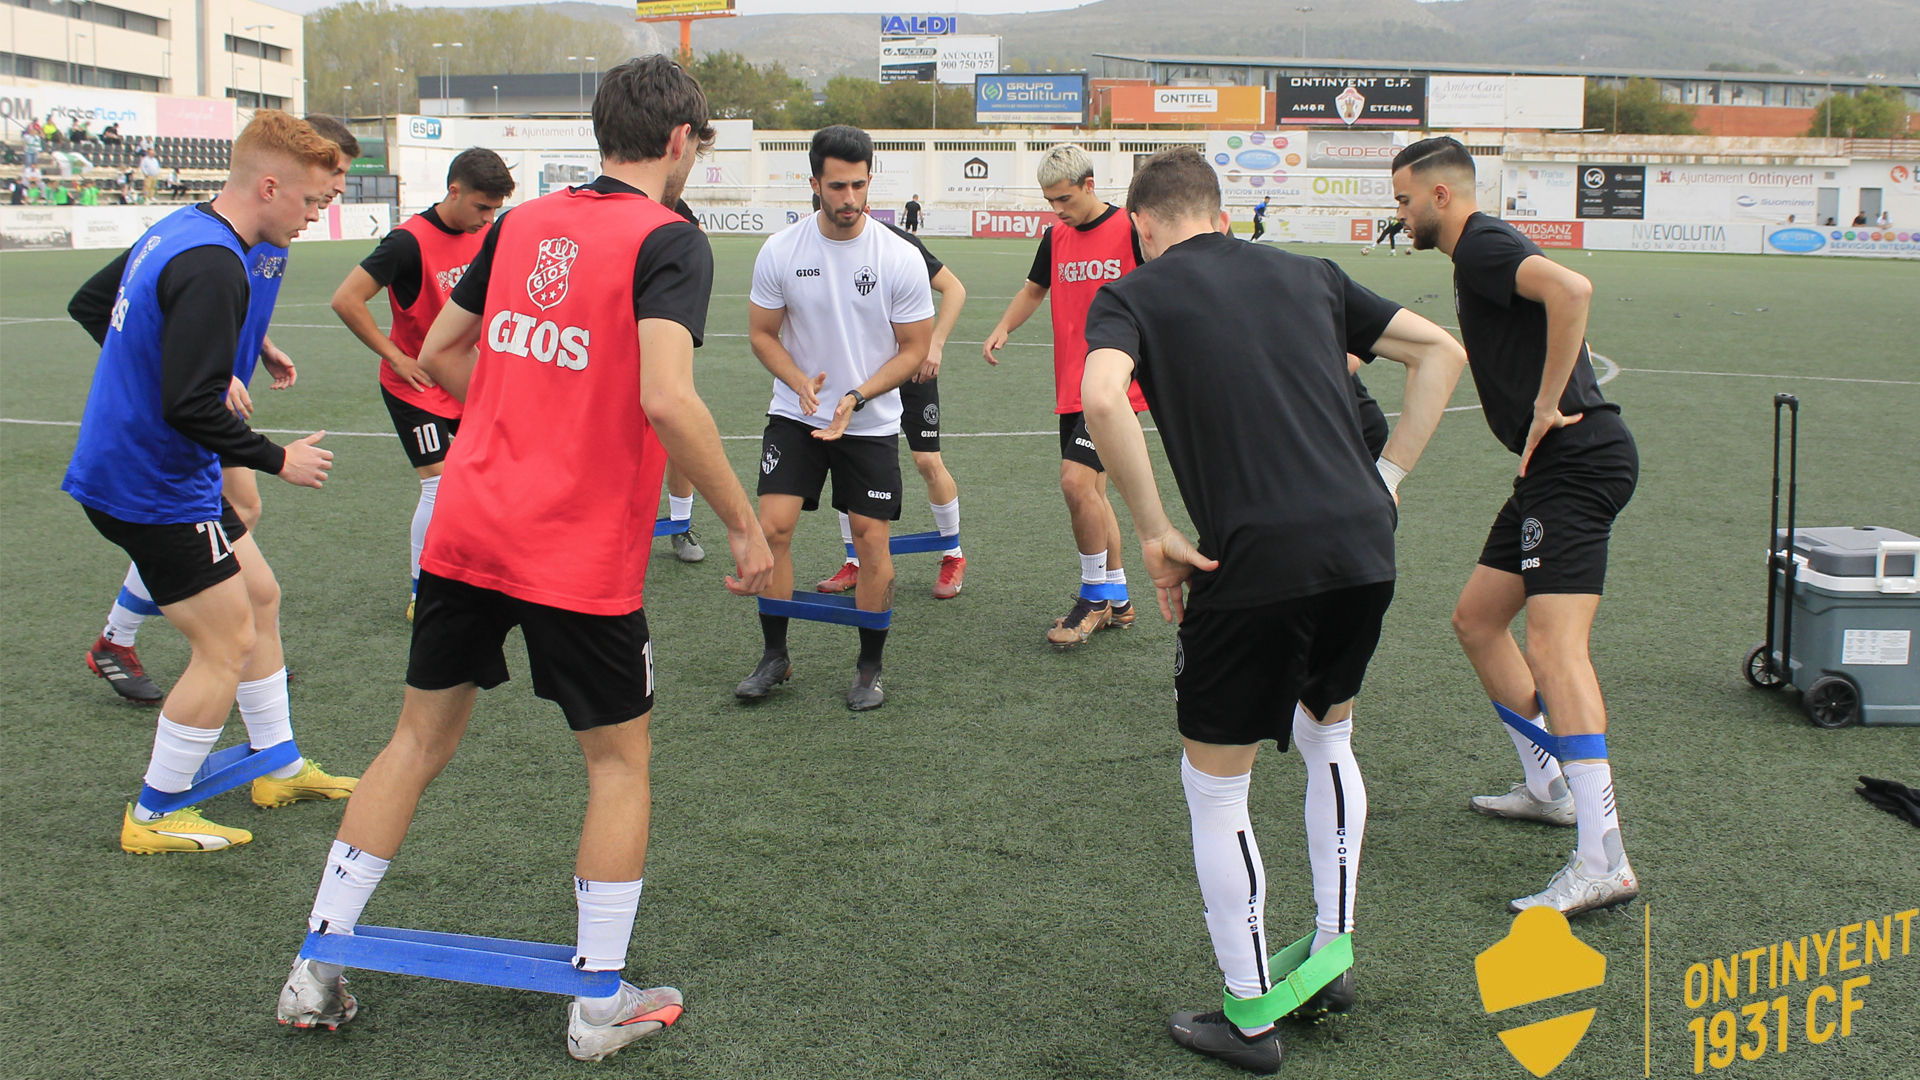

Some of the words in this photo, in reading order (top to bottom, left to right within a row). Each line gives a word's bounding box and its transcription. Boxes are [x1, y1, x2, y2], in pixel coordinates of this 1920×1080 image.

[883, 16, 957, 34] ALDI
[941, 51, 995, 60] ANÚNCIATE
[941, 61, 957, 69] 900
[960, 61, 976, 69] 750
[978, 60, 994, 69] 757
[1006, 82, 1054, 90] GRUPO
[1291, 77, 1377, 88] ONTINYENT
[1384, 78, 1411, 88] C.F.
[1006, 90, 1079, 101] solitium
[1160, 94, 1212, 103] ONTITEL
[521, 127, 574, 138] Ajuntament
[1679, 172, 1744, 185] Ajuntament
[1748, 171, 1814, 187] Ontinyent
[1761, 197, 1815, 207] Suominen
[975, 211, 1041, 238] Pinay
[533, 262, 568, 289] GIOS
[796, 268, 820, 277] GIOS
[1064, 259, 1122, 282] GIOS
[488, 310, 590, 371] GIOS
[412, 423, 440, 455] 10
[921, 430, 938, 438] GIOS
[867, 489, 892, 500] GIOS
[641, 638, 654, 698] 1
[1336, 829, 1347, 864] GIOS
[1248, 896, 1259, 932] GIOS
